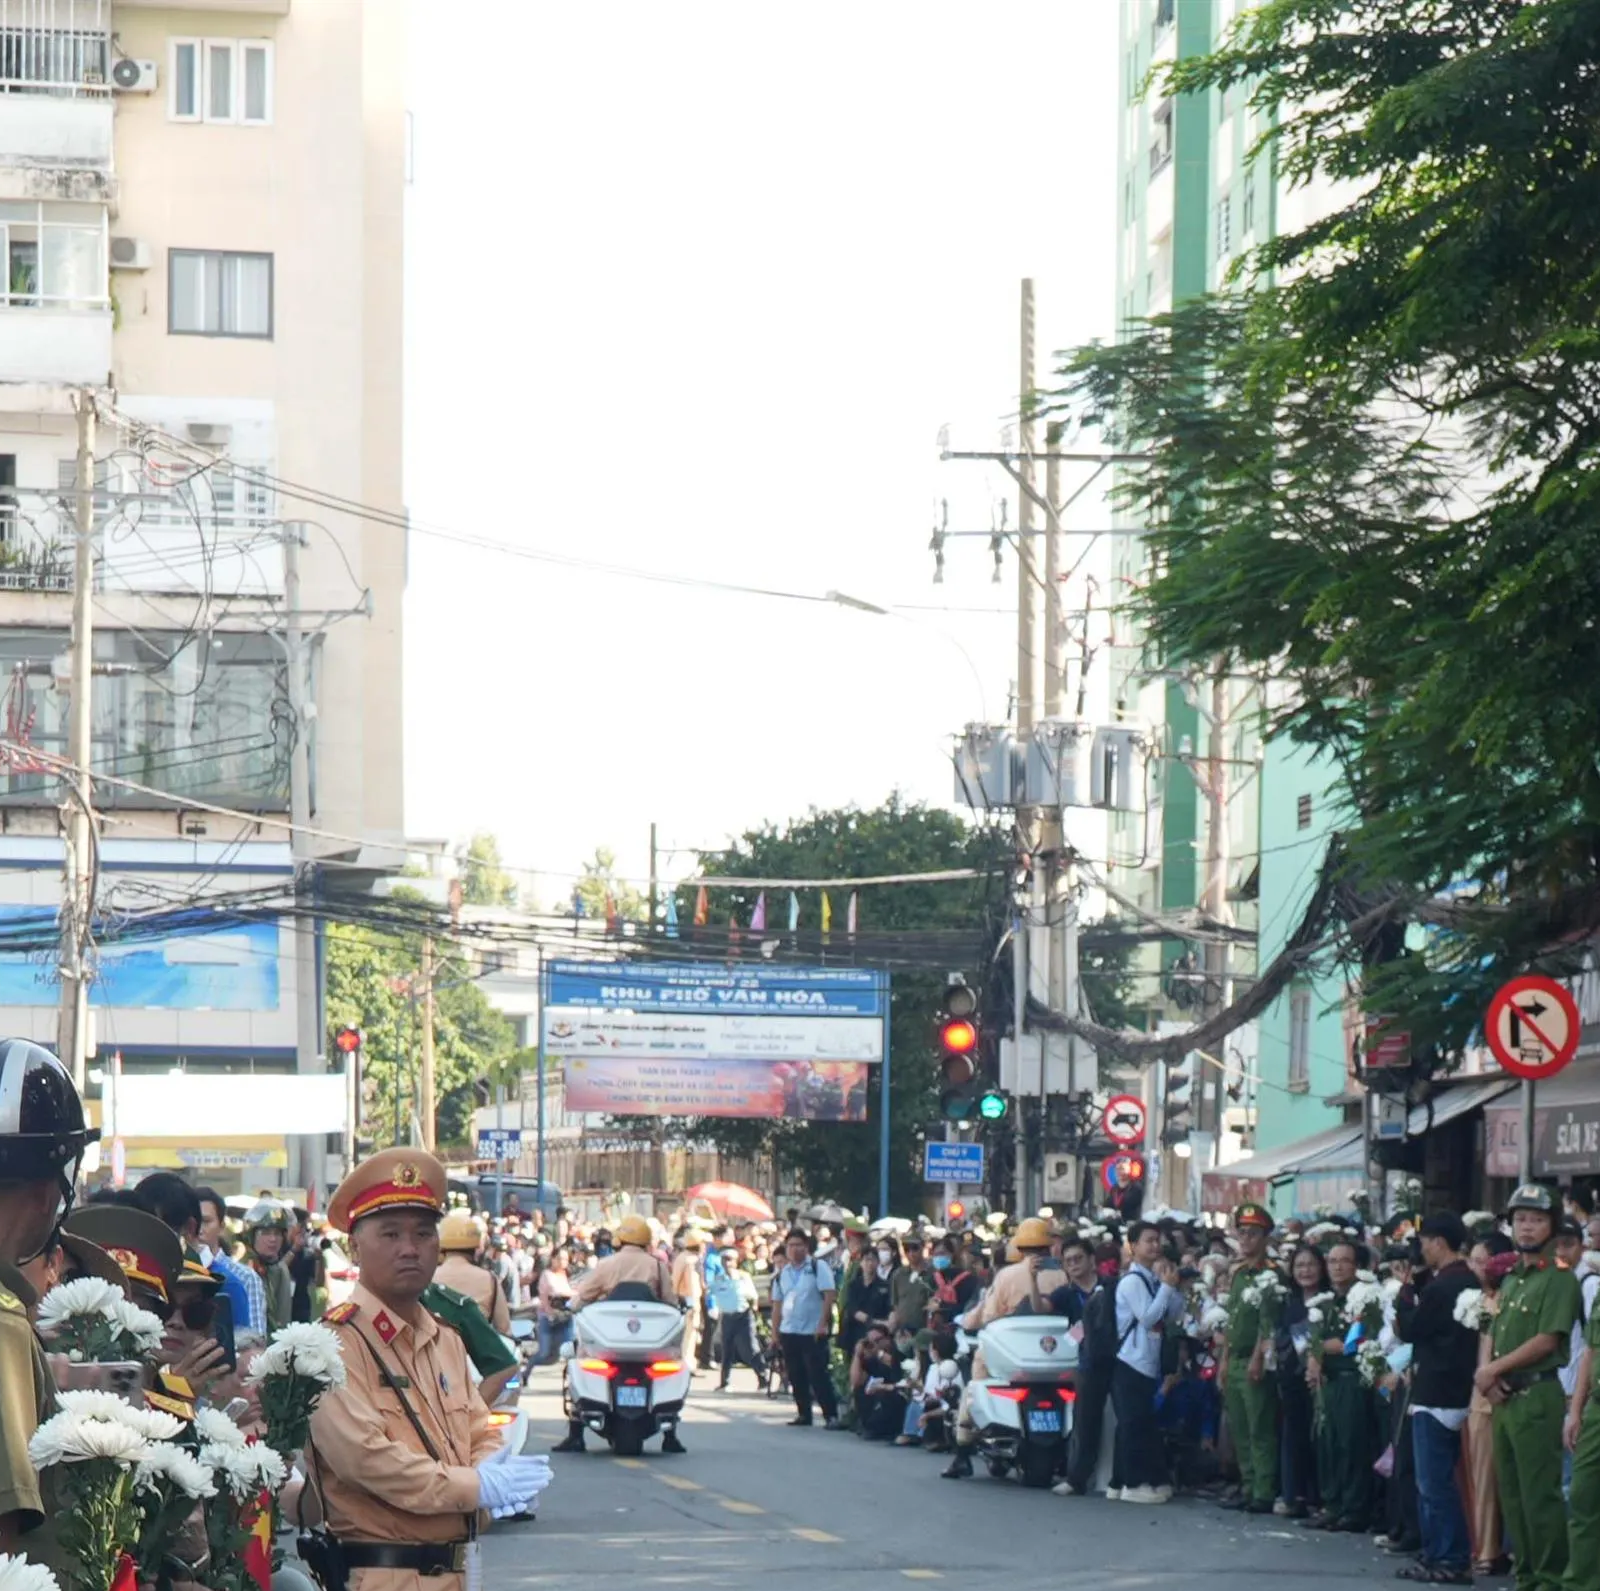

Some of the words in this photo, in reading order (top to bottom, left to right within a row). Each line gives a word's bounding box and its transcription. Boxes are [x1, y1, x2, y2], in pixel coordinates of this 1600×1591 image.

[601, 985, 653, 1000] KHU
[659, 985, 712, 1001] PHỐ
[717, 988, 768, 1004] VĂN
[774, 988, 827, 1004] HÓA
[1583, 1121, 1599, 1153] XE
